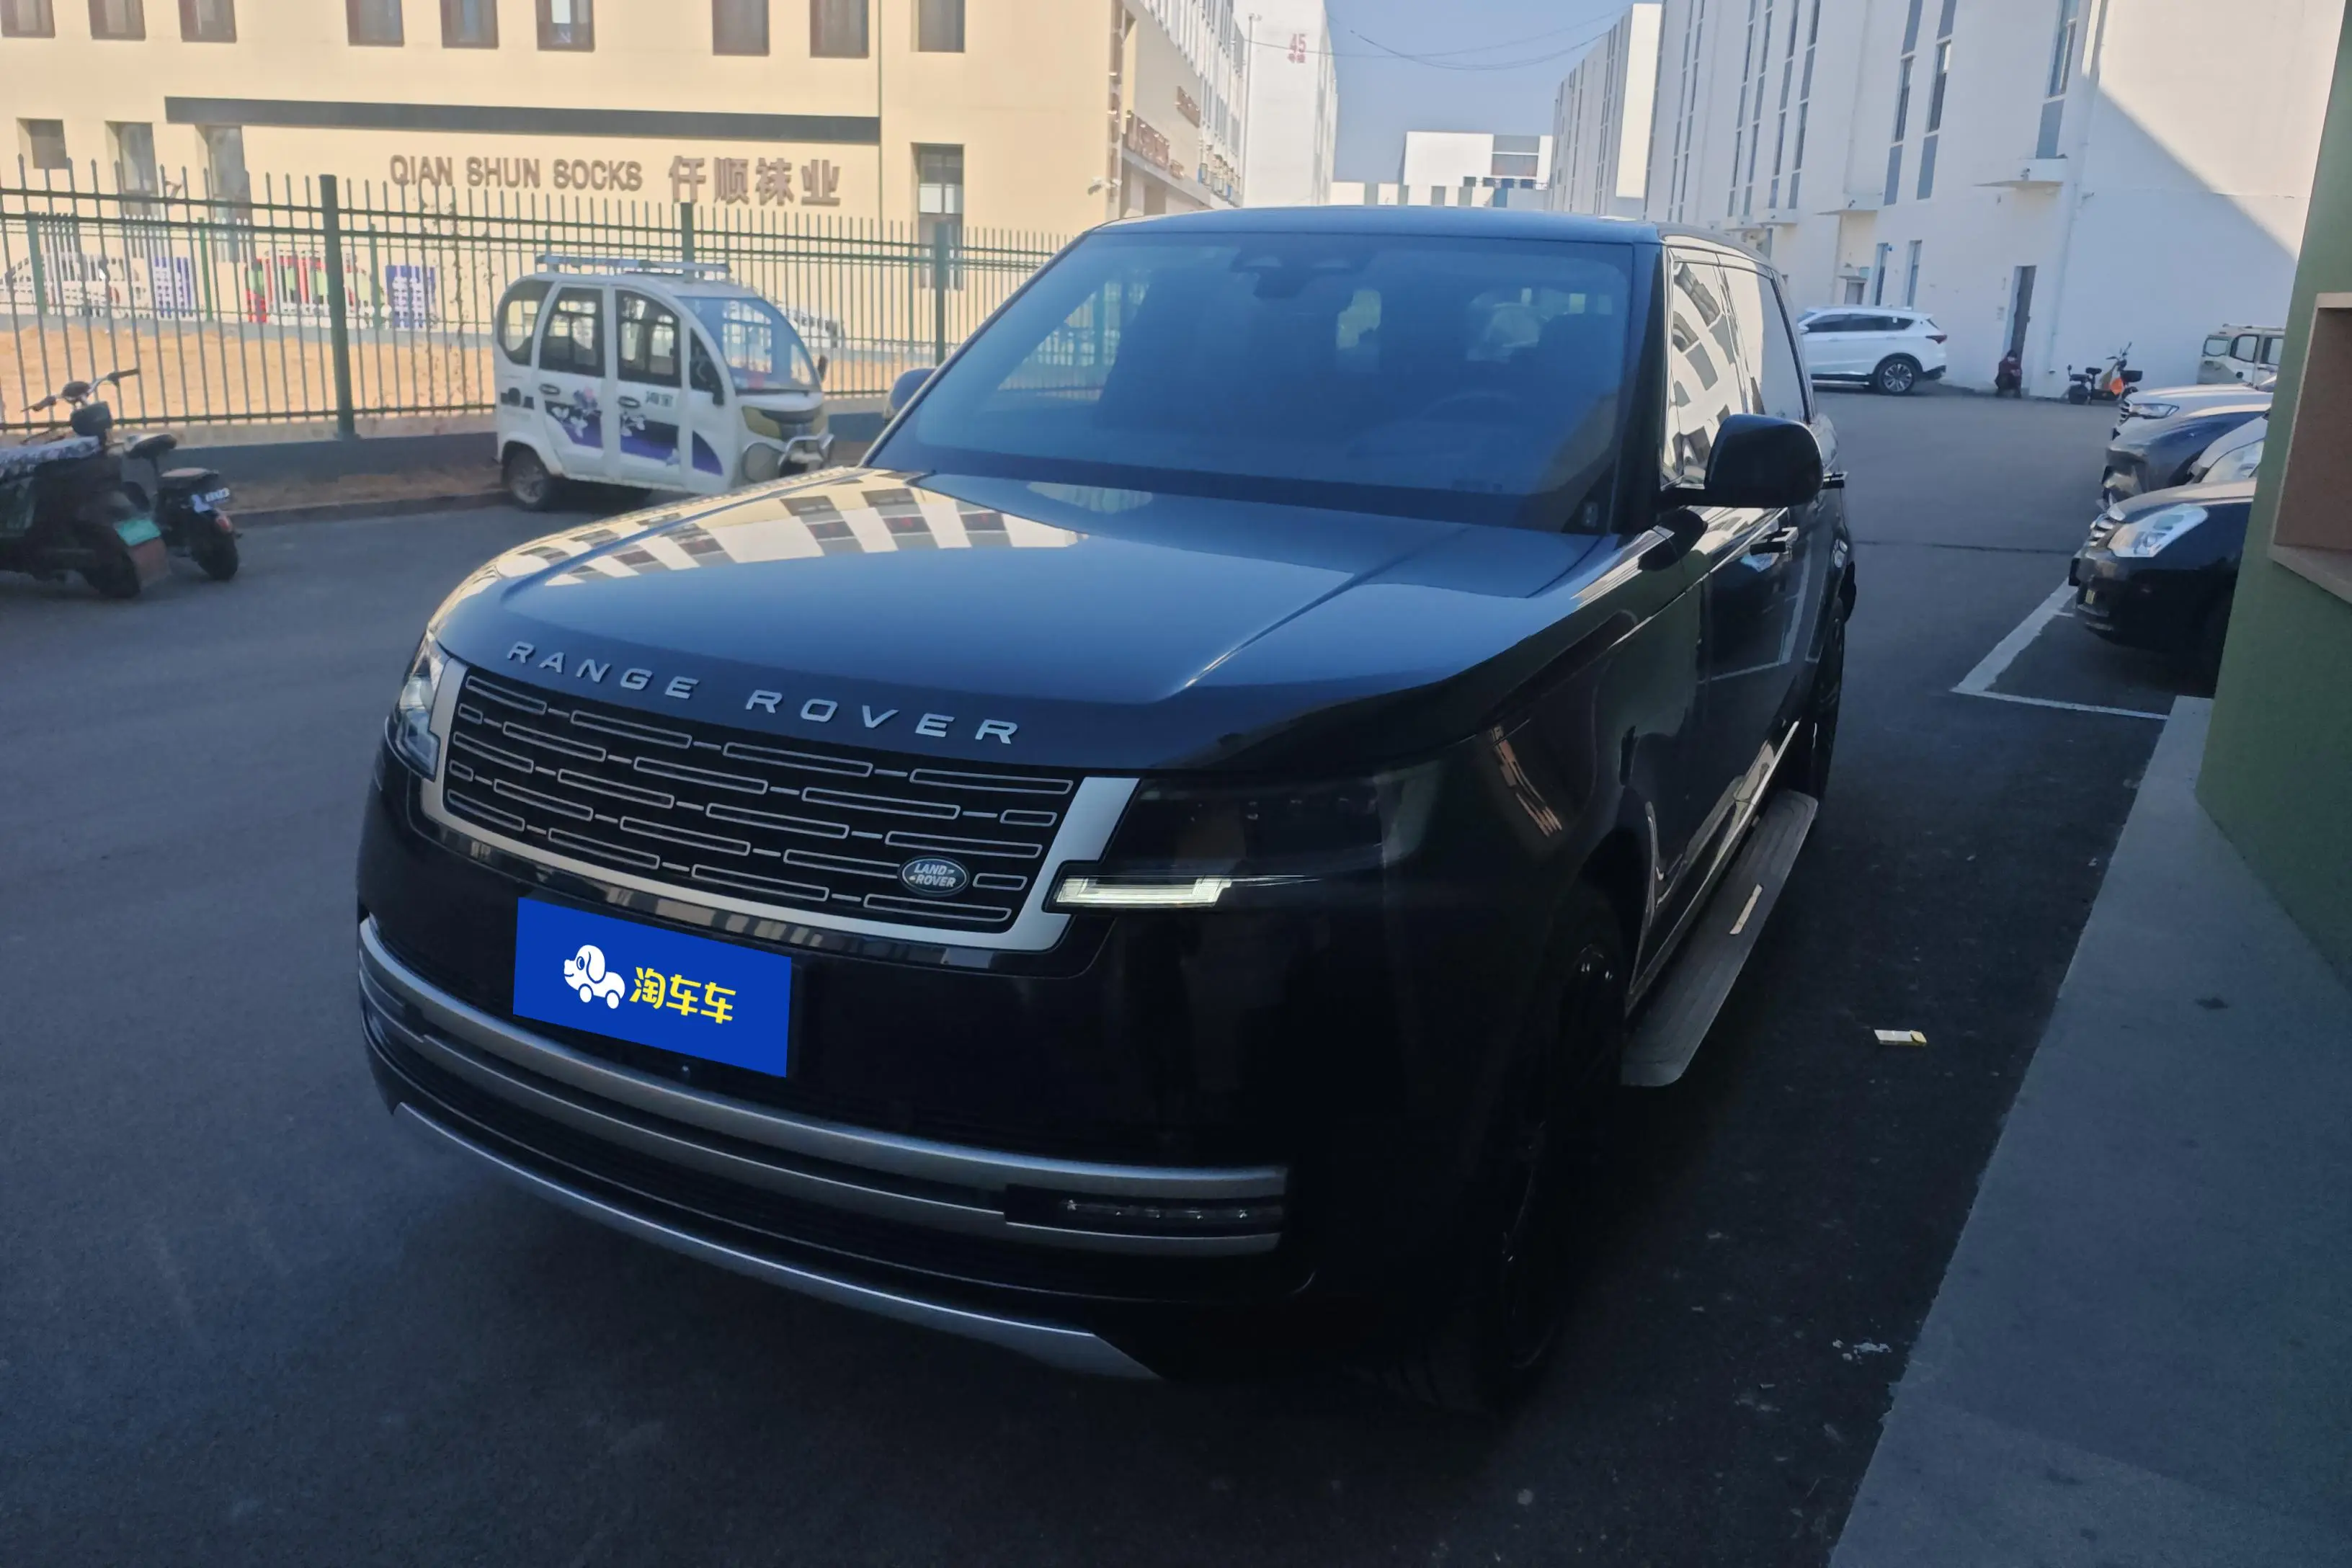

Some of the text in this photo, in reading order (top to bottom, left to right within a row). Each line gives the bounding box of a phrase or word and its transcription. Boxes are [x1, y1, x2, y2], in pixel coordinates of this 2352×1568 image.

[390, 155, 643, 192] QIAN SHUN SOCKS
[668, 155, 842, 207] 仟顺袜业
[507, 641, 1018, 744] RANGE ROVER
[914, 863, 948, 876] LAND
[915, 874, 956, 888] ROVER
